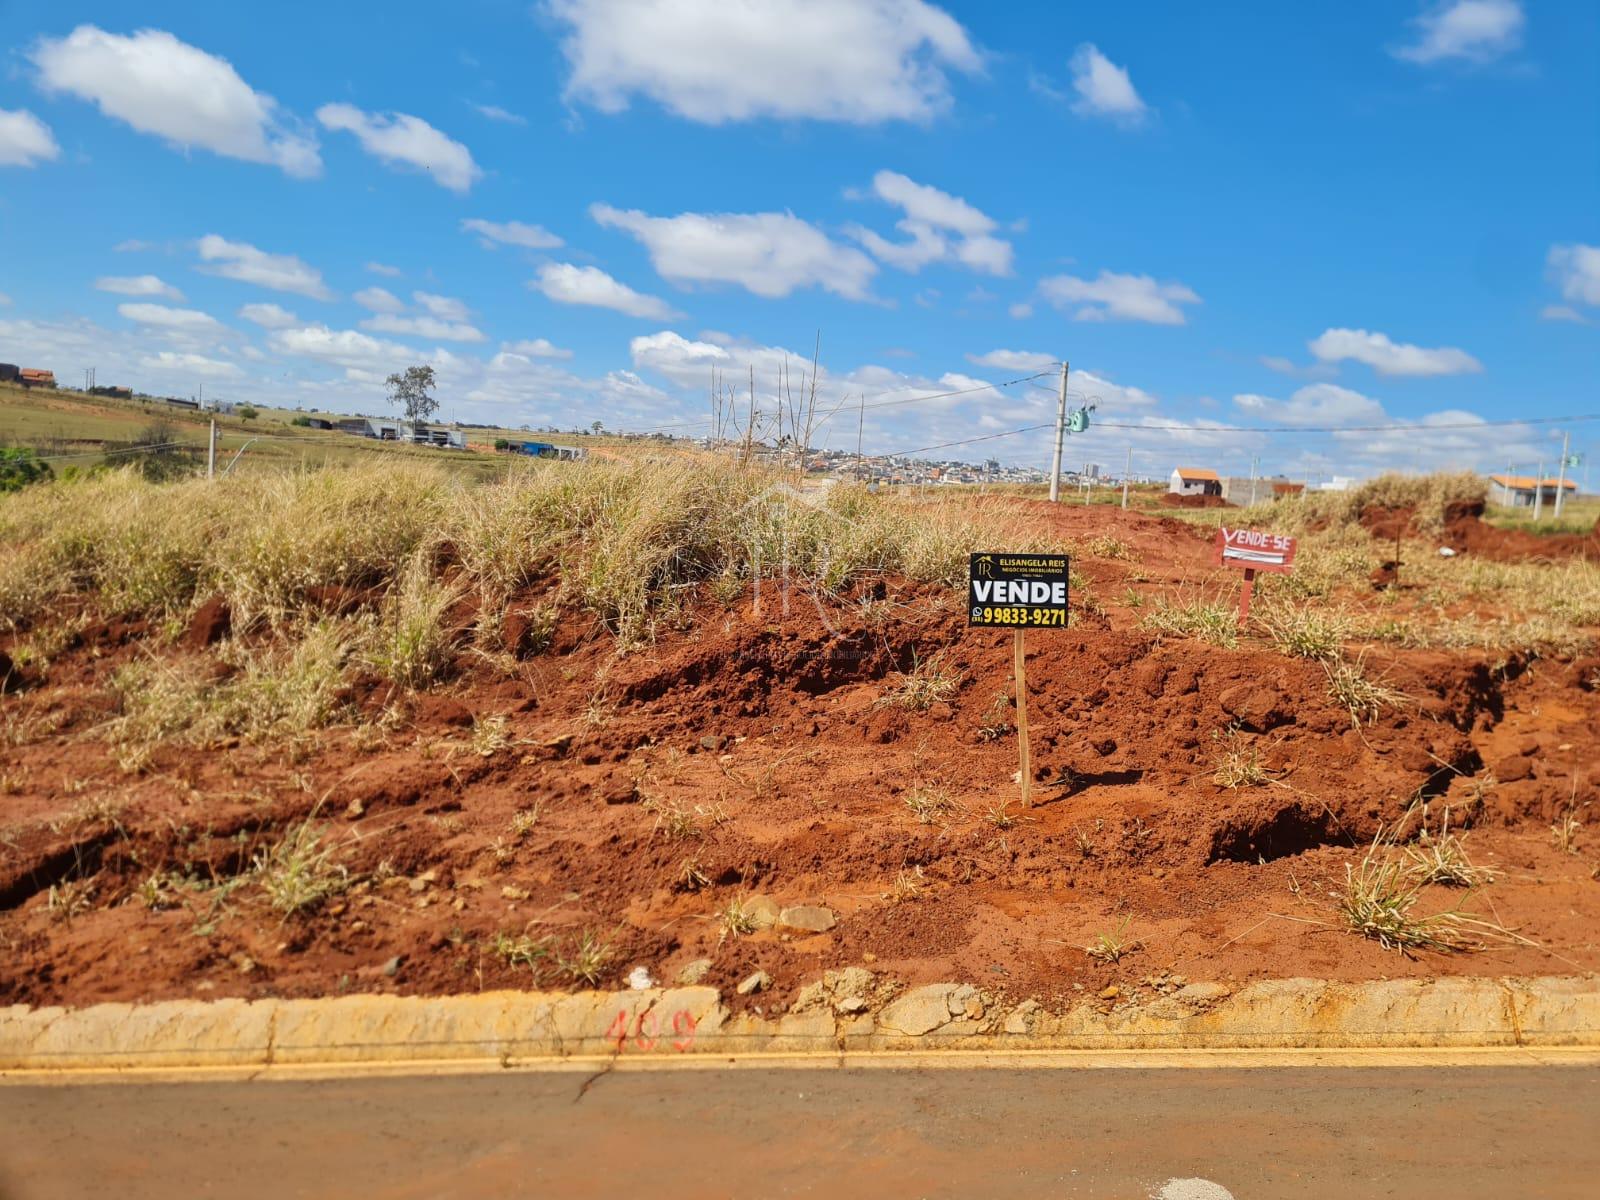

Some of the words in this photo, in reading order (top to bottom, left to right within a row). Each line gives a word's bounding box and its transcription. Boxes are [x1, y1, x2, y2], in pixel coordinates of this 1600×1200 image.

[999, 558, 1048, 567] ELISANGELA
[1048, 559, 1065, 568] REIS
[972, 580, 1066, 604] VENDE
